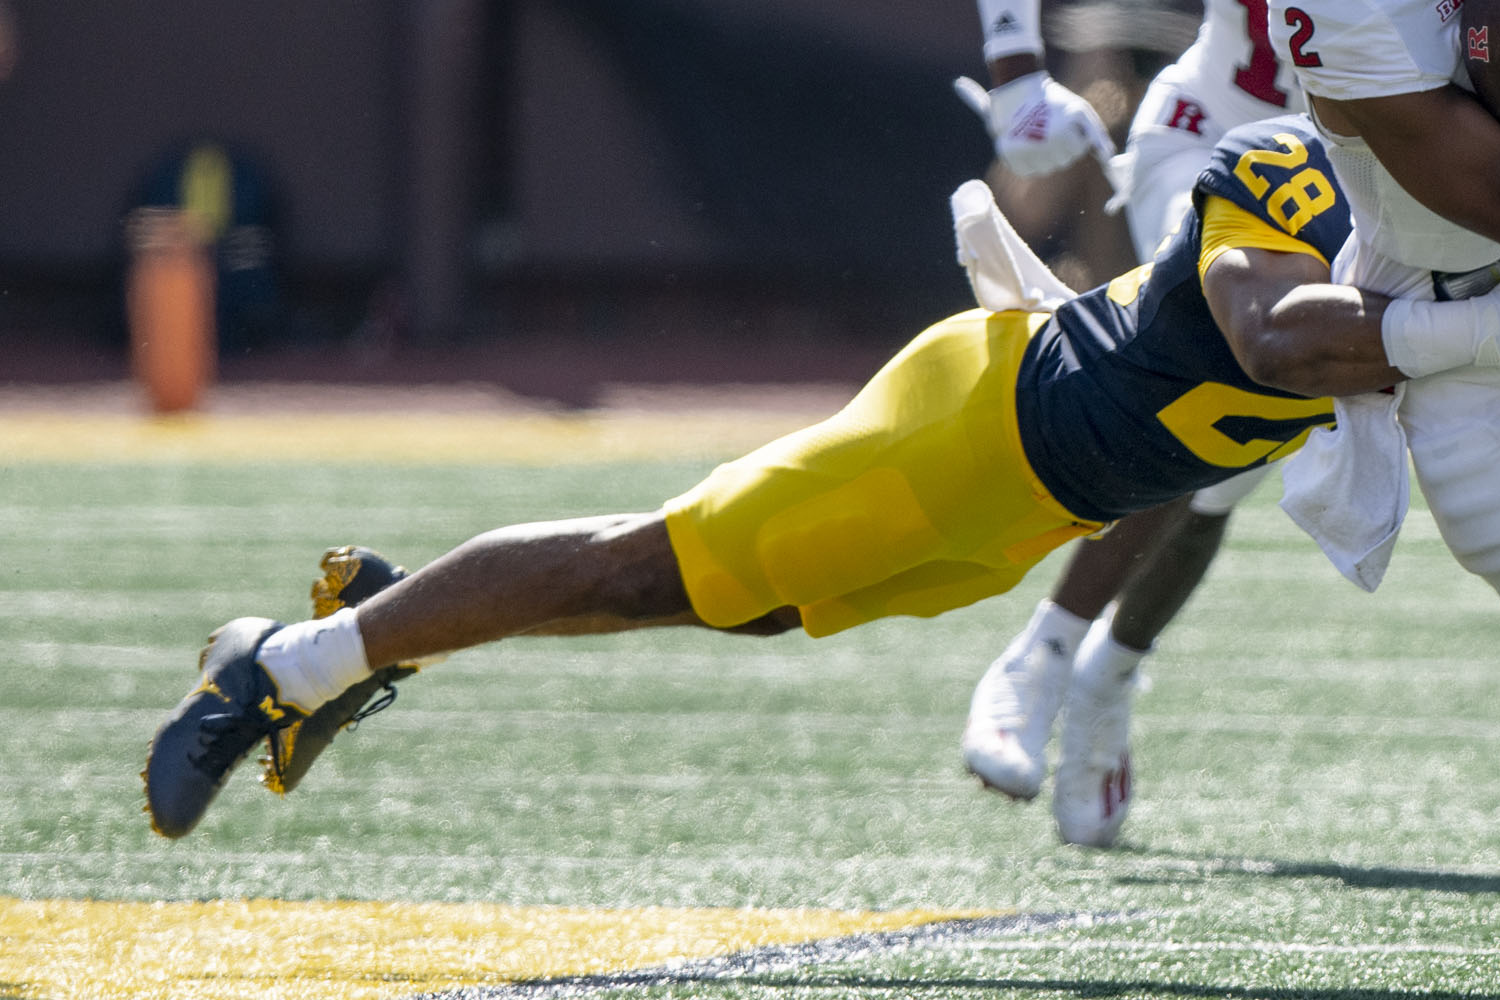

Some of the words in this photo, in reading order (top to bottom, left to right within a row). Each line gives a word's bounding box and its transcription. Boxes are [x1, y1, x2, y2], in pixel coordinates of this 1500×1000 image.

[1285, 7, 1323, 67] 2
[1468, 26, 1489, 62] R
[1168, 99, 1206, 136] R
[1233, 133, 1336, 236] 28
